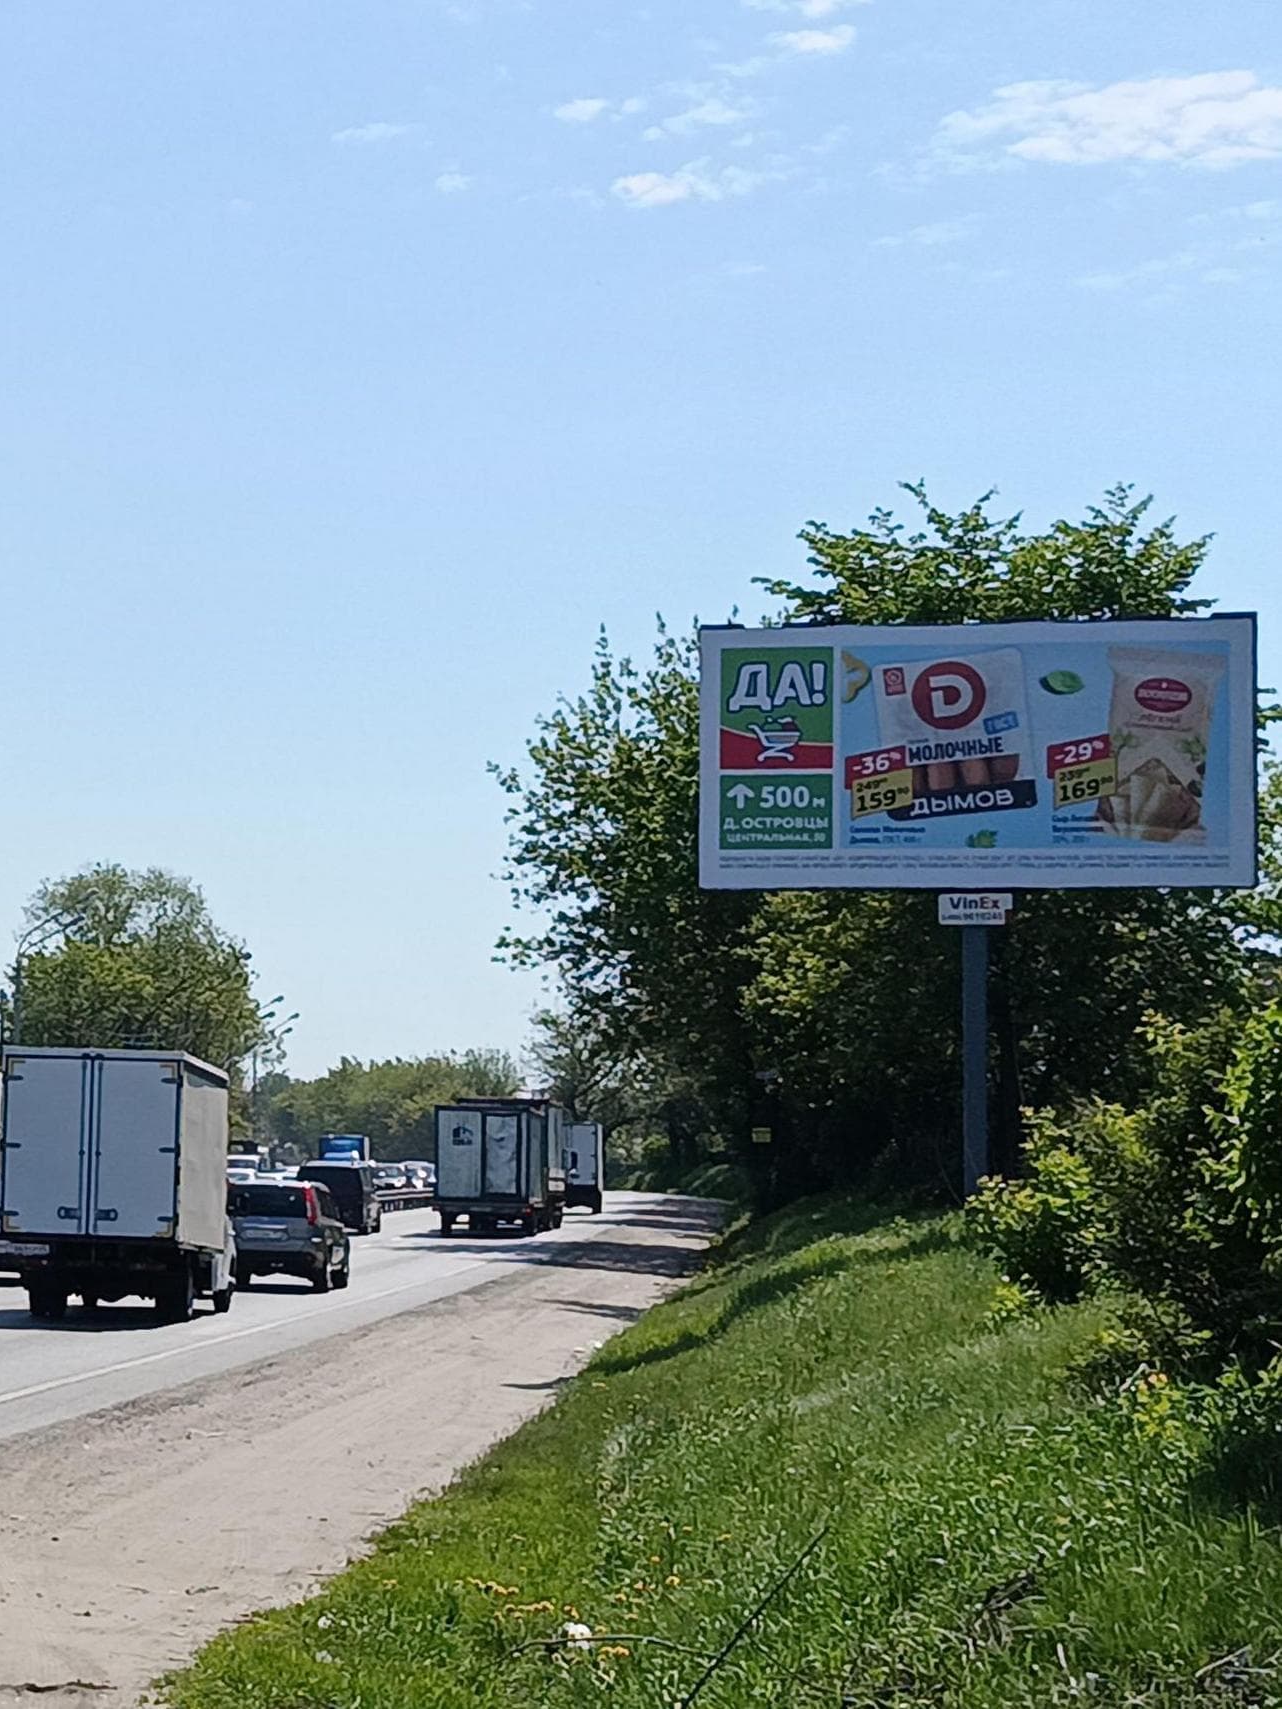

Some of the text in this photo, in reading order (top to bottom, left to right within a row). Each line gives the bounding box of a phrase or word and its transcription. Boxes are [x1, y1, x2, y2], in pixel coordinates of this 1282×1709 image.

[728, 661, 826, 713] ДА!
[908, 737, 1004, 763] МОЛОЧНЫЕ
[759, 785, 810, 808] 500
[910, 789, 1014, 817] ДЫМОВ
[741, 817, 829, 830] ОСТРОВЦЫ
[949, 896, 1000, 909] VinEx
